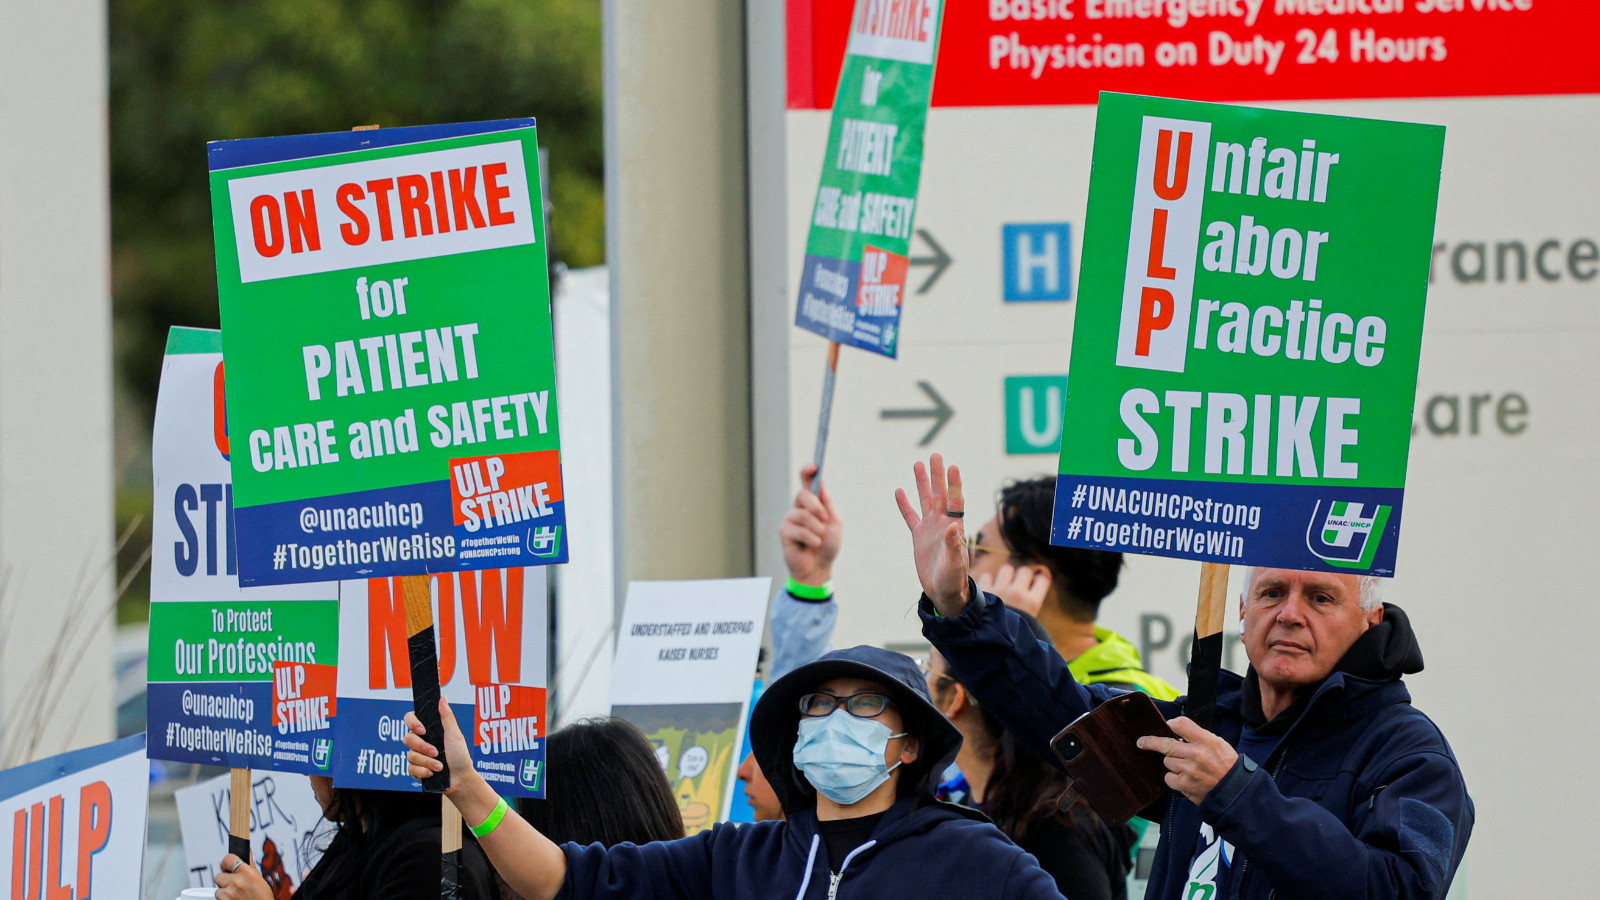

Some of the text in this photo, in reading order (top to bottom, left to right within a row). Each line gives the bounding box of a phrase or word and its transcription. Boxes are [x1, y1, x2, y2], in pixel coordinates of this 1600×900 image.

[989, 0, 1074, 21] Basic
[1086, 0, 1263, 28] Emergency
[989, 28, 1447, 80] Physician on Duty 24 Hours
[837, 118, 898, 177] PATIENT
[250, 162, 515, 258] ON STRIKE
[860, 192, 914, 239] SAFETY
[863, 252, 887, 284] ULP
[1018, 232, 1060, 293] H
[356, 276, 408, 320] for
[859, 284, 900, 317] STRIKE
[302, 323, 479, 401] PATIENT
[250, 390, 549, 473] CARE and SAFETY
[1019, 386, 1061, 447] U
[1412, 390, 1529, 437] are
[1117, 388, 1361, 479] STRIKE
[453, 457, 505, 498] ULP
[300, 501, 423, 533] @unacuhcp
[460, 481, 554, 532] STRIKE
[1071, 483, 1261, 530] #UNACUHCPstrong
[1327, 519, 1371, 529] UNAC/UHCP
[273, 532, 455, 570] #TogetherWeRise
[459, 547, 520, 559] #UNACUHCPstrong
[461, 534, 520, 548] #TogetherWeWin
[1067, 515, 1244, 558] #TogetherWeWin
[211, 608, 273, 633] To Protect
[631, 620, 755, 637] UNDERSTAFFED AND UNDERPAID
[175, 635, 316, 675] Our Professions
[658, 646, 719, 662] KAISER NURSES
[275, 665, 306, 701] ULP
[182, 690, 254, 724] @unacuhcp
[277, 696, 330, 735] STRIKE
[478, 685, 512, 721] ULP
[166, 722, 272, 757] #TogetherWeRise
[479, 716, 539, 755] STRIKE
[11, 781, 113, 900] ULP
